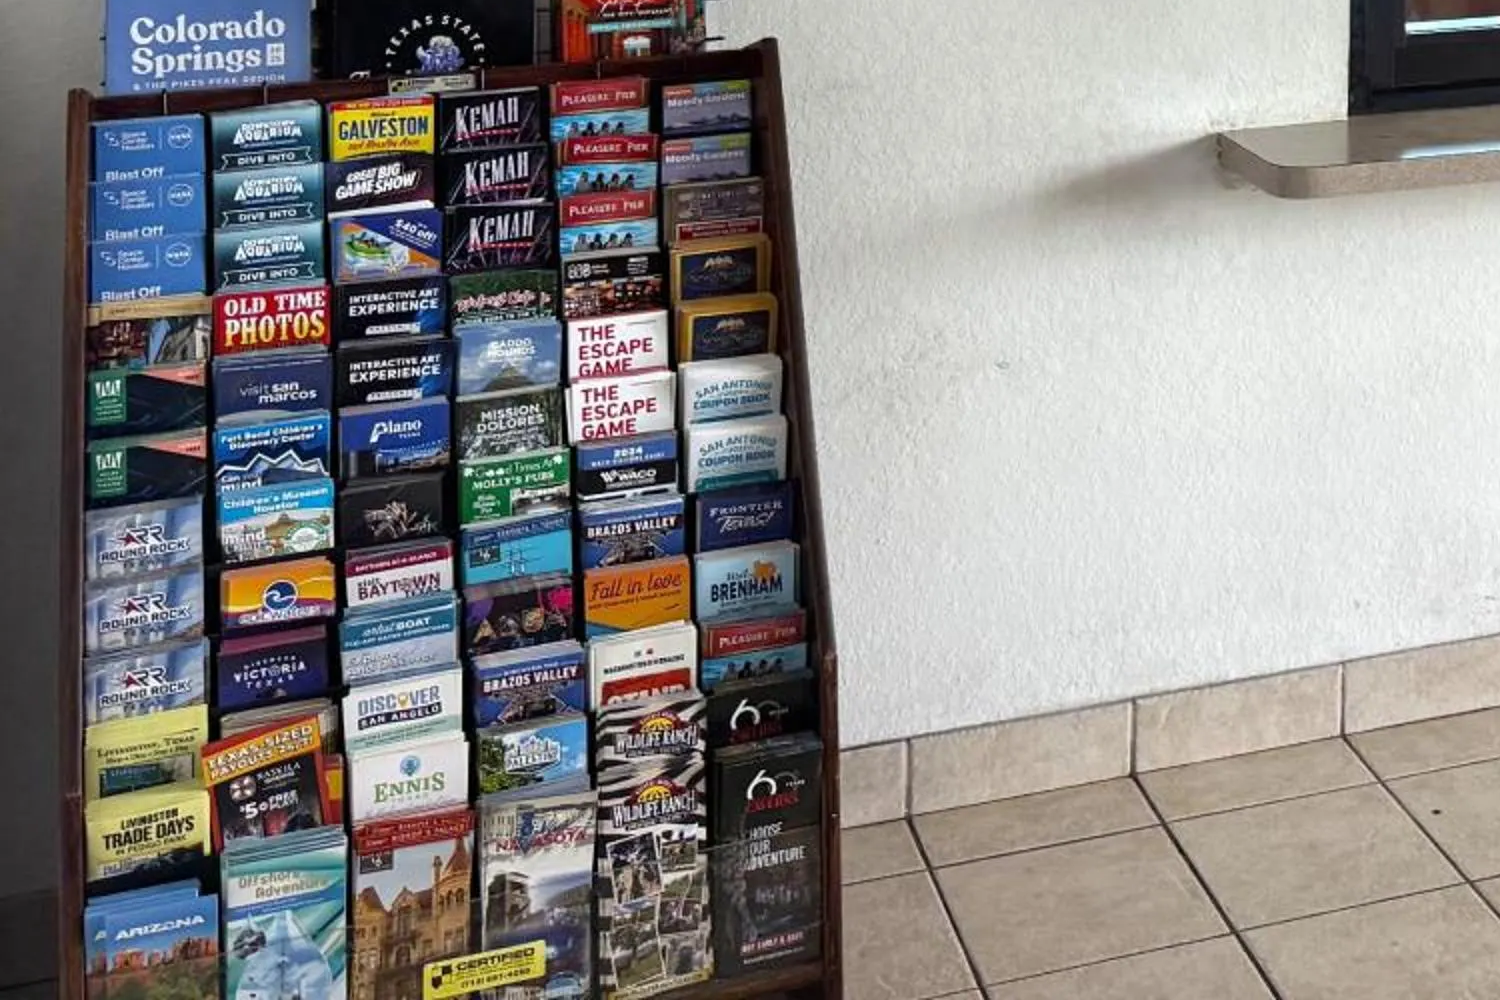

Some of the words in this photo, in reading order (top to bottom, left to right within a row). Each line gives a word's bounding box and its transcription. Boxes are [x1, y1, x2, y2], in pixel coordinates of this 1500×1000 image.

[130, 10, 286, 45] Colorado
[386, 16, 433, 56] TEXAS
[441, 15, 485, 52] STATE
[131, 44, 260, 78] Springs
[561, 91, 609, 106] PLEASURE
[455, 97, 519, 133] KEMAH
[233, 125, 302, 145] AQUARIUM
[339, 116, 428, 140] GALVESTON
[573, 141, 622, 155] PLEASURE
[627, 141, 649, 152] PIER
[238, 156, 264, 165] DIVE
[267, 152, 295, 163] INTO
[106, 169, 139, 183] Blast
[142, 166, 164, 177] Off
[378, 162, 402, 176] BIG
[465, 151, 529, 190] KEMAH
[234, 182, 304, 201] AQUARIUM
[336, 180, 373, 200] GAME
[374, 170, 417, 194] SHOW
[239, 212, 265, 221] DIVE
[269, 209, 297, 219] INTO
[568, 202, 617, 216] PLEASURE
[622, 200, 644, 211] PIER
[106, 228, 139, 241] Blast
[142, 225, 164, 237] Off
[468, 209, 535, 252] KEMAH
[235, 241, 305, 261] AQUARIUM
[239, 272, 266, 282] DIVE
[269, 268, 298, 279] INTO
[101, 289, 135, 300] Blast
[138, 285, 161, 298] Off
[350, 290, 417, 304] INTERACTIVE
[418, 288, 440, 297] ART
[224, 298, 267, 317] OLD
[274, 290, 326, 311] TIME
[349, 299, 439, 317] EXPERIENCE
[225, 310, 326, 347] PHOTOS
[578, 324, 616, 342] THE
[578, 338, 653, 360] ESCAPE
[350, 356, 417, 371] INTERACTIVE
[420, 354, 441, 364] ART
[578, 357, 633, 377] GAME
[349, 365, 441, 383] EXPERIENCE
[240, 383, 270, 396] visit
[272, 381, 299, 393] san
[259, 389, 317, 404] marcos
[581, 385, 619, 403] THE
[481, 404, 539, 421] MISSION
[581, 398, 658, 422] ESCAPE
[694, 397, 739, 410] COUPON
[370, 419, 422, 443] Plano
[477, 414, 544, 433] DOLORES
[581, 417, 637, 441] GAME
[698, 454, 742, 468] COUPON
[587, 522, 632, 538] BRAZOS
[634, 516, 677, 533] VALLEY
[101, 546, 147, 562] ROUND
[150, 540, 185, 554] ROCK
[358, 572, 440, 600] BAYTOWN
[711, 575, 783, 602] BRENHAM
[102, 615, 148, 631] ROUND
[151, 608, 186, 622] ROCK
[396, 616, 431, 629] BOAT
[719, 632, 768, 648] PLEASURE
[233, 661, 306, 682] VICTORIA
[483, 674, 530, 693] BRAZOS
[533, 666, 578, 683] VALLEY
[102, 689, 148, 705] ROUND
[151, 681, 187, 696] ROCK
[360, 714, 386, 729] SAN
[391, 704, 439, 720] ANGELO
[265, 725, 312, 746] SIZED
[374, 772, 445, 803] ENNIS
[121, 807, 178, 830] LIVINGSTON
[102, 827, 153, 850] TRADE
[156, 815, 194, 838] DAYS
[115, 915, 205, 941] ARIZONA
